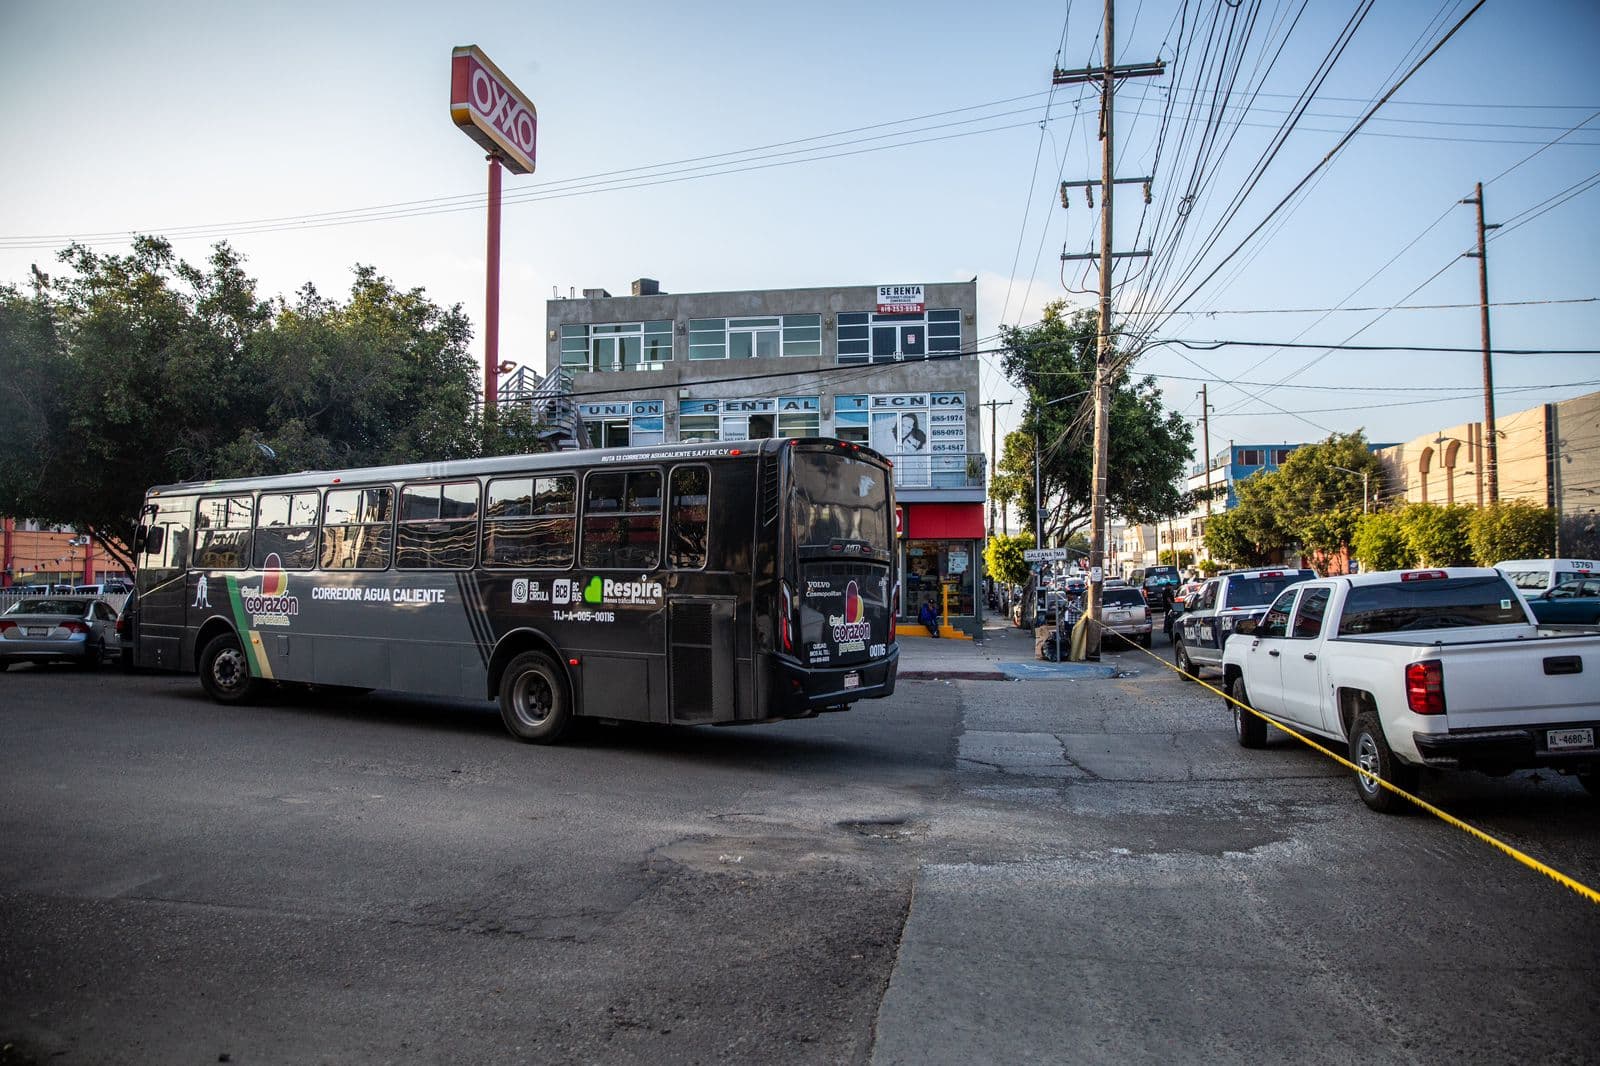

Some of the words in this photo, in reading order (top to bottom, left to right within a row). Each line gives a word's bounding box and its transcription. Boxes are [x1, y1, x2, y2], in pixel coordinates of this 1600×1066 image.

[473, 68, 534, 153] OXXO
[880, 287, 891, 296] SE
[893, 286, 921, 295] RENTA
[589, 404, 659, 415] UNION
[703, 401, 816, 413] DENTAL
[853, 396, 963, 407] TECNICA
[622, 453, 650, 461] CORREDOR
[1570, 561, 1594, 569] 13761
[555, 585, 568, 598] BCB
[603, 574, 663, 604] Respira
[807, 581, 831, 589] VOLVO
[312, 587, 362, 600] CORREDOR
[364, 588, 391, 601] AGUA
[393, 589, 446, 603] CALIENTE
[246, 590, 298, 615] corazón
[553, 610, 615, 623] TIJ-A-005-00116
[833, 618, 871, 643] corazón
[869, 644, 886, 657] 00116
